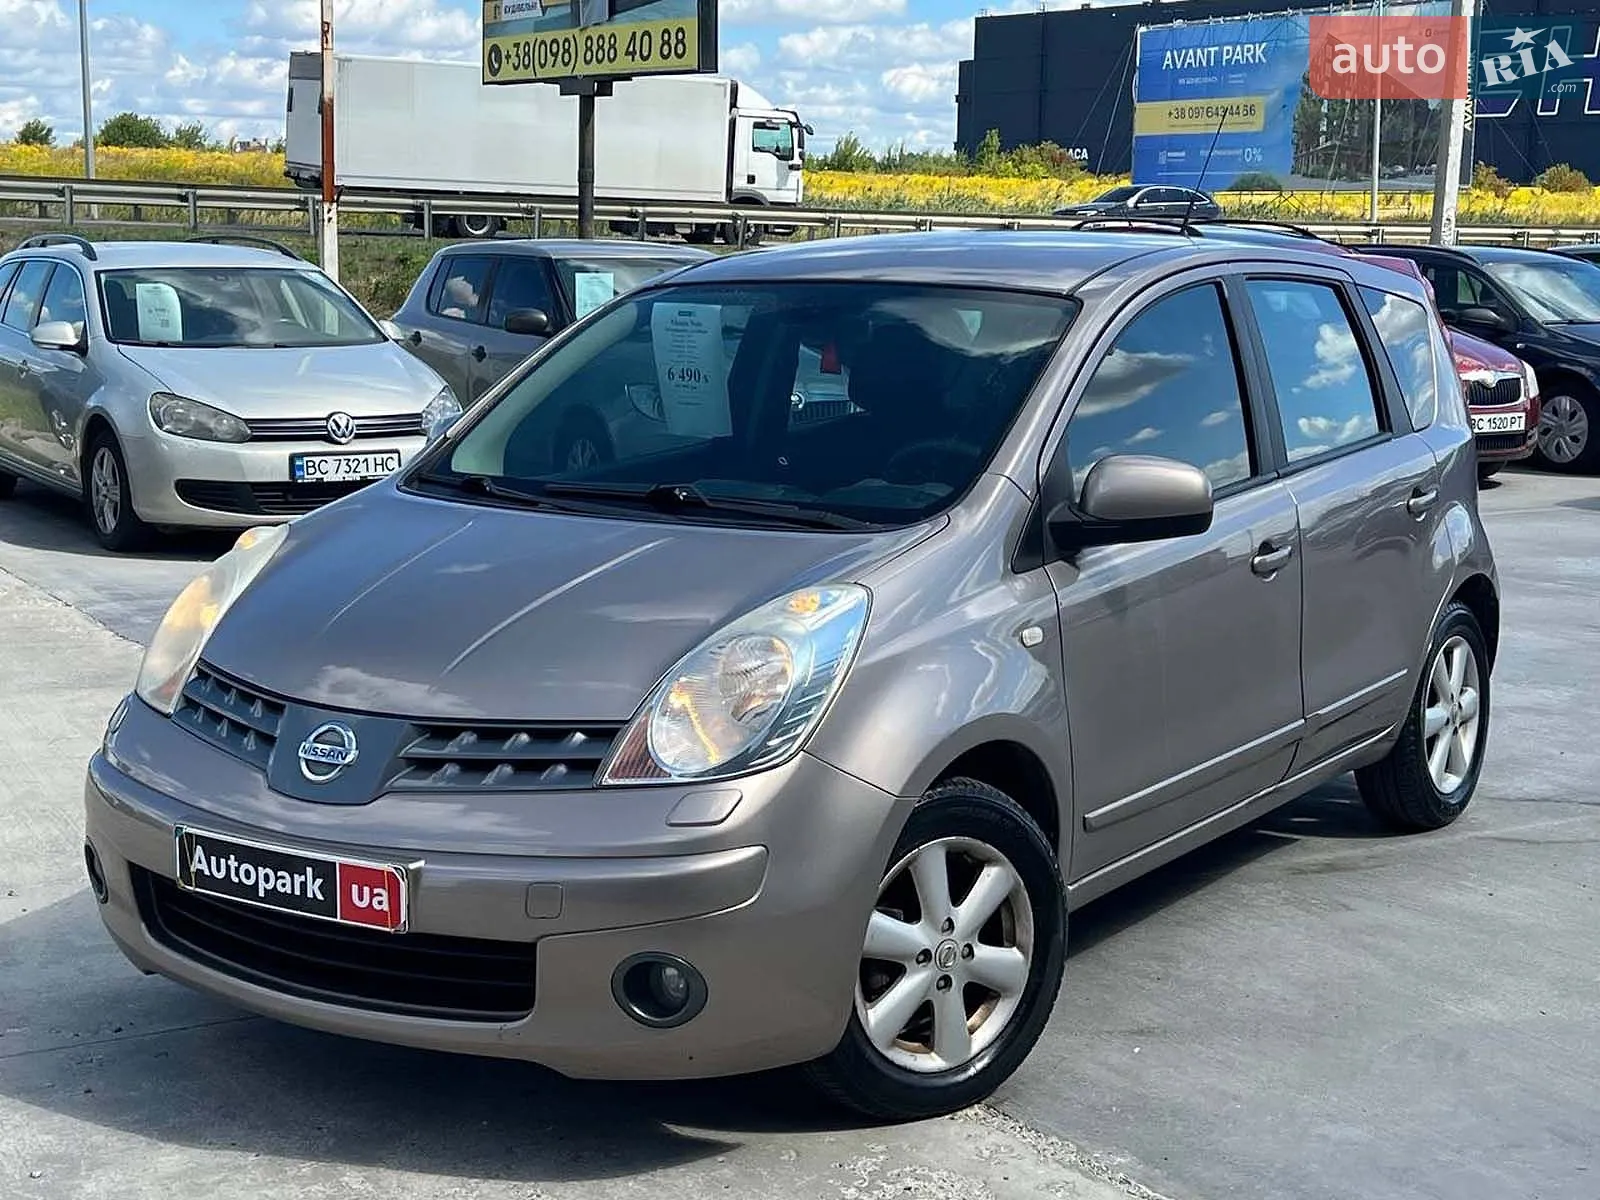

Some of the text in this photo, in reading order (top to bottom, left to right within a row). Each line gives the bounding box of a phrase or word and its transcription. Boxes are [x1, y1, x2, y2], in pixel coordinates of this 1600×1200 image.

[504, 27, 687, 77] +38(098) 888 40 88
[1162, 42, 1268, 71] AVANT PARK
[678, 367, 702, 384] 490
[1487, 416, 1509, 430] 1520
[1509, 415, 1523, 429] PT
[305, 456, 396, 476] BC 7321 HC
[301, 743, 348, 761] NISSAN
[191, 845, 389, 912] Autopark ua
